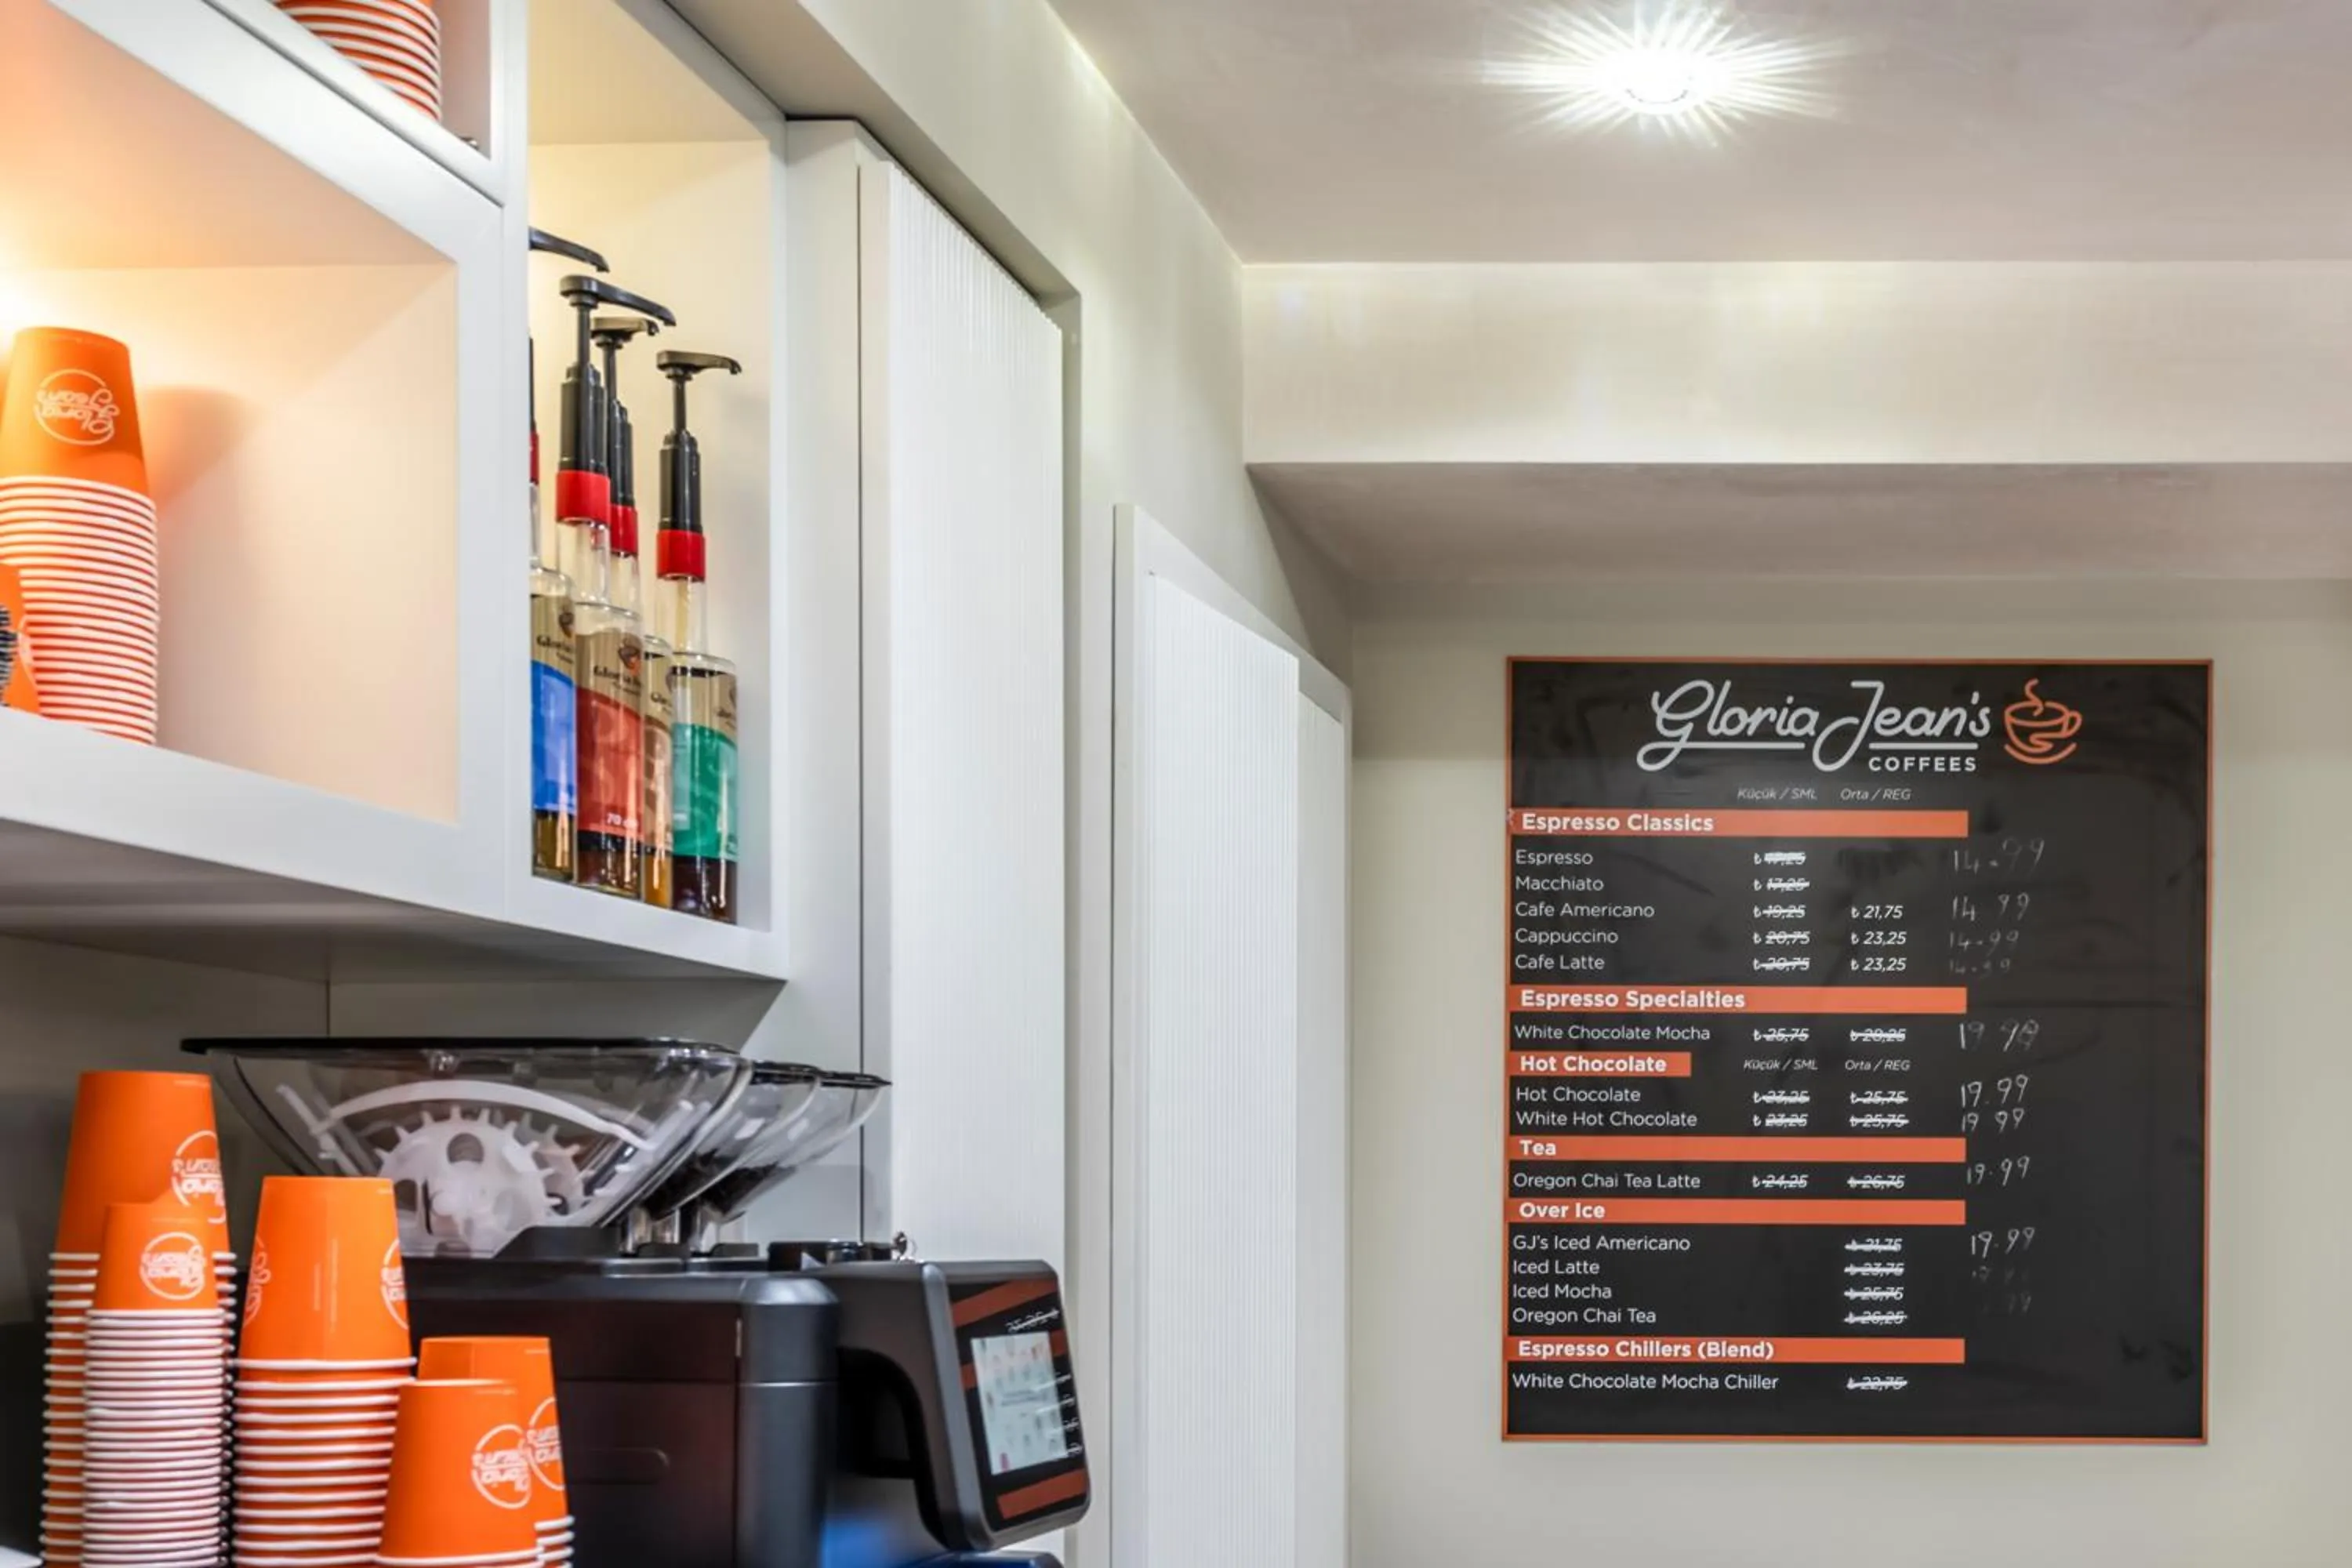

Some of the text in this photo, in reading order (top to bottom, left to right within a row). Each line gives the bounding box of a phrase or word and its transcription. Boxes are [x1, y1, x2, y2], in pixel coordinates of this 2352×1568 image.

[1636, 679, 1991, 771] Gloria Jean's
[1868, 757, 1976, 772] COFFEES
[1840, 787, 1870, 800] Orta
[1882, 788, 1911, 800] REG
[1523, 813, 1715, 833] Espresso Classics
[1515, 849, 1594, 866] Espresso
[1515, 876, 1605, 891] Macchiato
[1515, 901, 1655, 918] Cafe Americano
[1863, 905, 1904, 920] 21,75
[1515, 927, 1619, 946] Cappuccino
[1863, 931, 1907, 946] 23,25
[1515, 953, 1606, 970] Cafe Latte
[1862, 956, 1907, 973] 23,25
[1521, 989, 1746, 1011] Espresso Specialties
[1514, 1025, 1711, 1040] White Chocolate Mocha
[1520, 1054, 1668, 1073] Hot Chocolate
[1845, 1059, 1871, 1071] Orta
[1884, 1059, 1911, 1071] REG
[1516, 1086, 1641, 1102] Hot Chocolate
[1515, 1111, 1698, 1127] White Hot Chocolate
[1519, 1139, 1556, 1156] Tea
[1513, 1172, 1700, 1190] Oregon Chai Tea Latte
[1519, 1202, 1606, 1219] Over Ice
[1512, 1235, 1691, 1251] GJ's Iced Americano
[1513, 1259, 1600, 1275] Iced Latte
[1512, 1283, 1612, 1299] Iced Mocha
[1512, 1307, 1657, 1326] Oregon Chai Tea
[1519, 1340, 1774, 1360] Espresso Chillers (Blend)
[1512, 1373, 1779, 1390] White Chocolate Mocha Chiller
